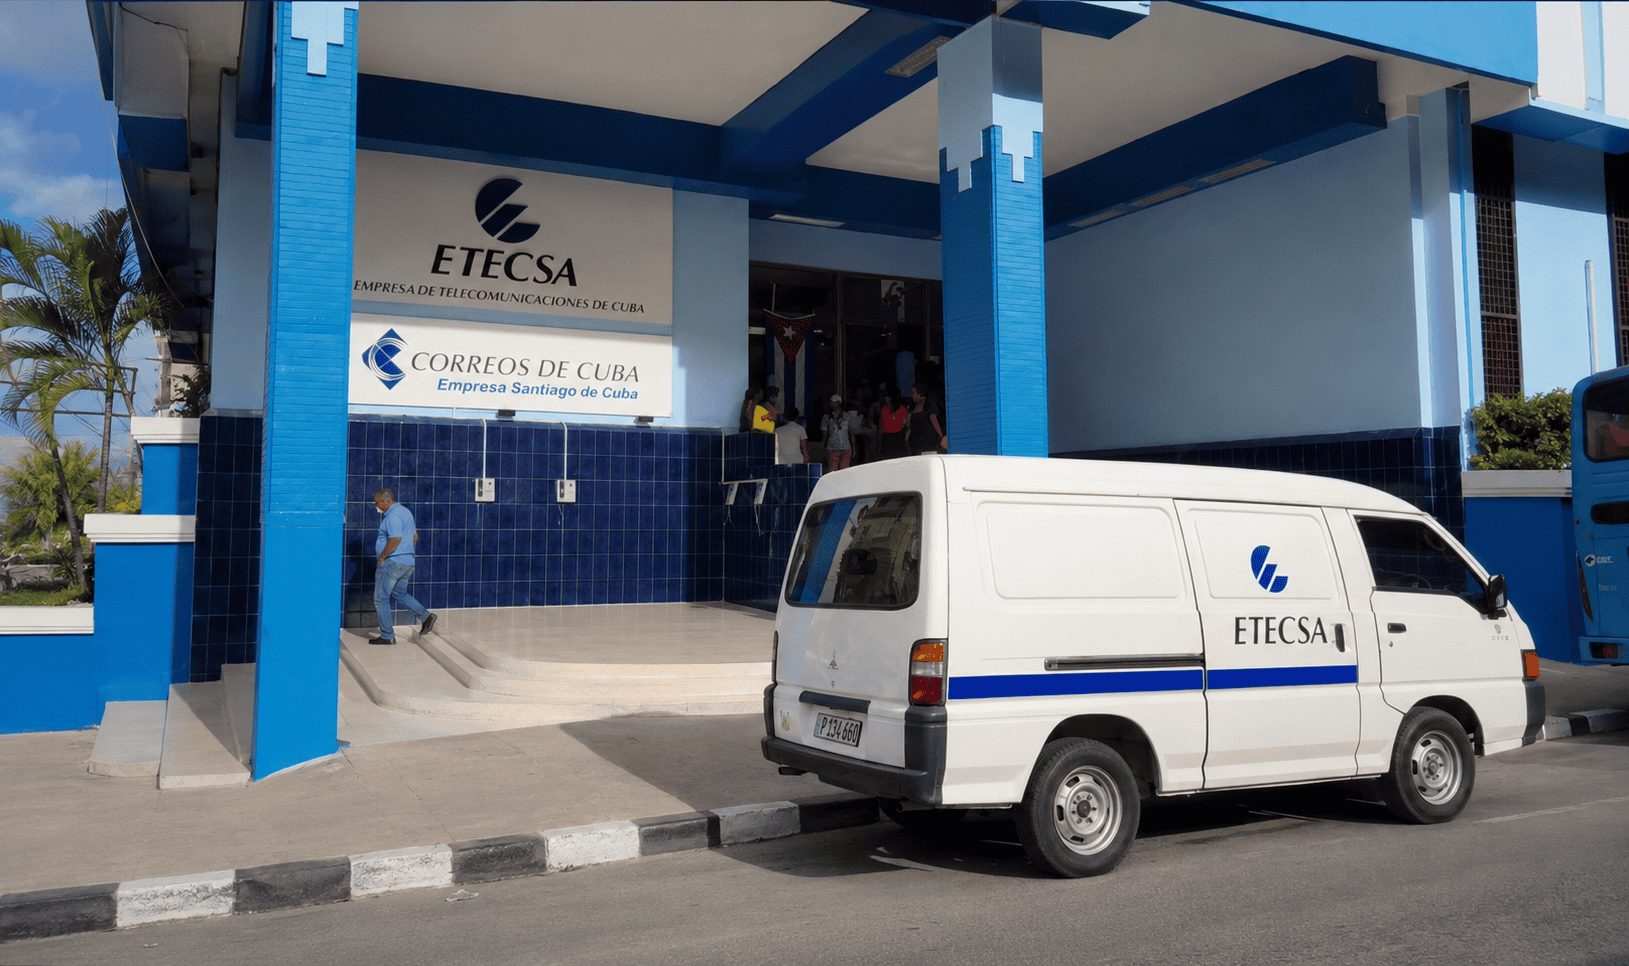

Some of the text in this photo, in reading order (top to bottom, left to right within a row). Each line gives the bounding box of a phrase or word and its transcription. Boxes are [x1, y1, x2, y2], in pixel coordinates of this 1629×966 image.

[431, 244, 578, 287] ETECSA
[353, 279, 645, 314] EMPRESA DE TELECOMUNICACIONES DE CUBA
[411, 351, 639, 383] CORREOS DE CUBA
[437, 378, 638, 400] Empresa Santiago de Cuba
[1234, 616, 1328, 645] ETECSA
